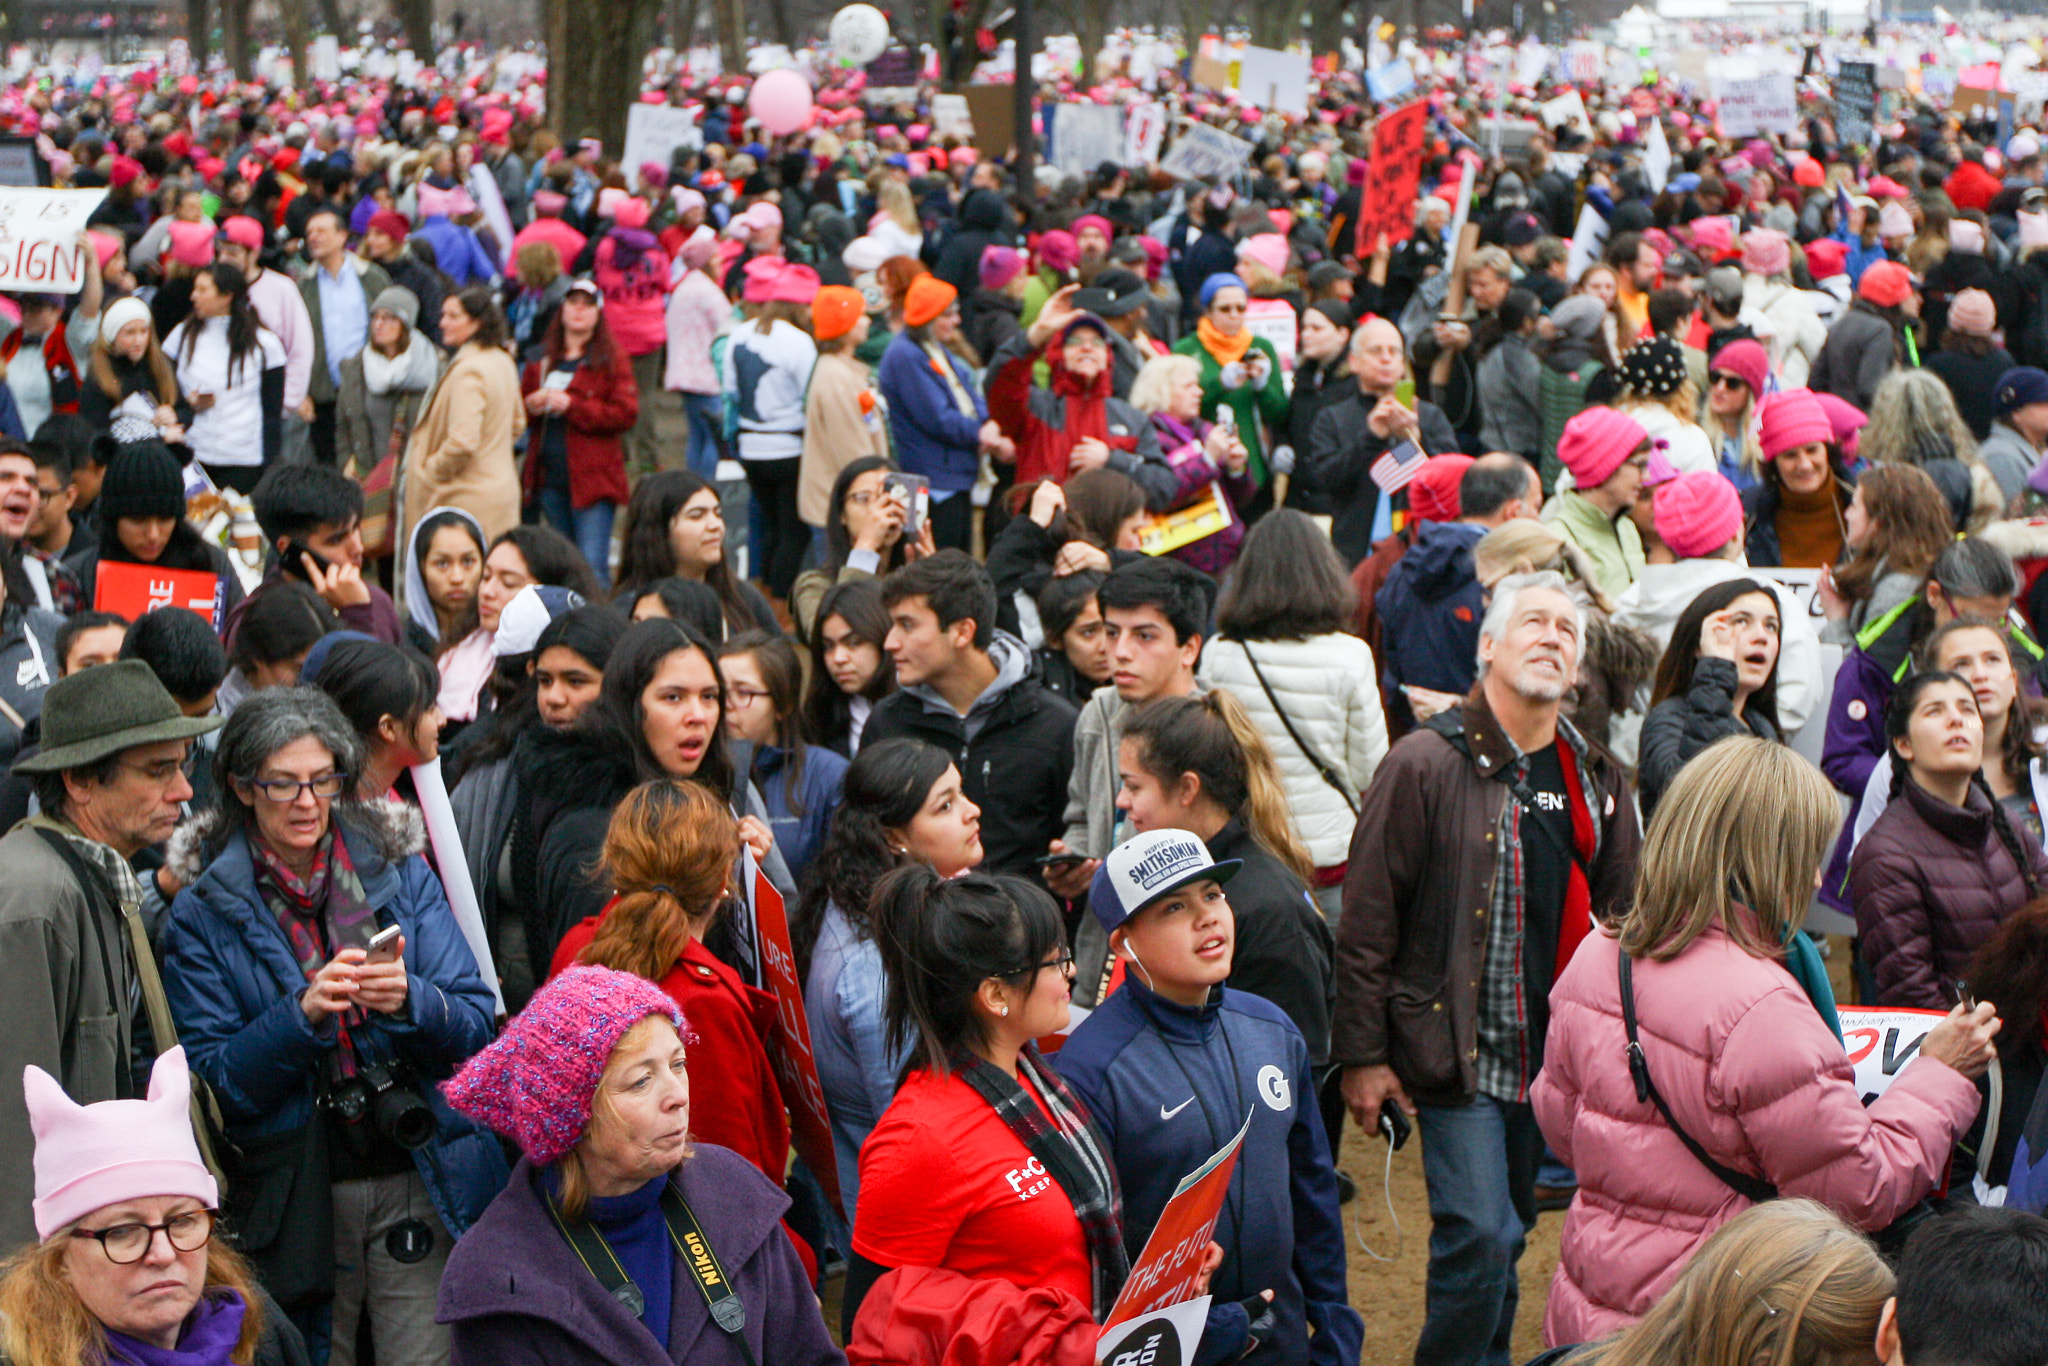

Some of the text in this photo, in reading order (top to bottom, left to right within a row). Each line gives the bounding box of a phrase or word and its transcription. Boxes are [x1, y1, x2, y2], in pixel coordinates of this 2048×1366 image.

[1129, 841, 1201, 885] SMITHSONIAN
[1257, 1064, 1291, 1111] G
[1018, 1176, 1050, 1201] KEEP
[684, 1231, 721, 1286] Nikon
[1123, 1250, 1172, 1304] THE
[1140, 1333, 1163, 1366] ON
